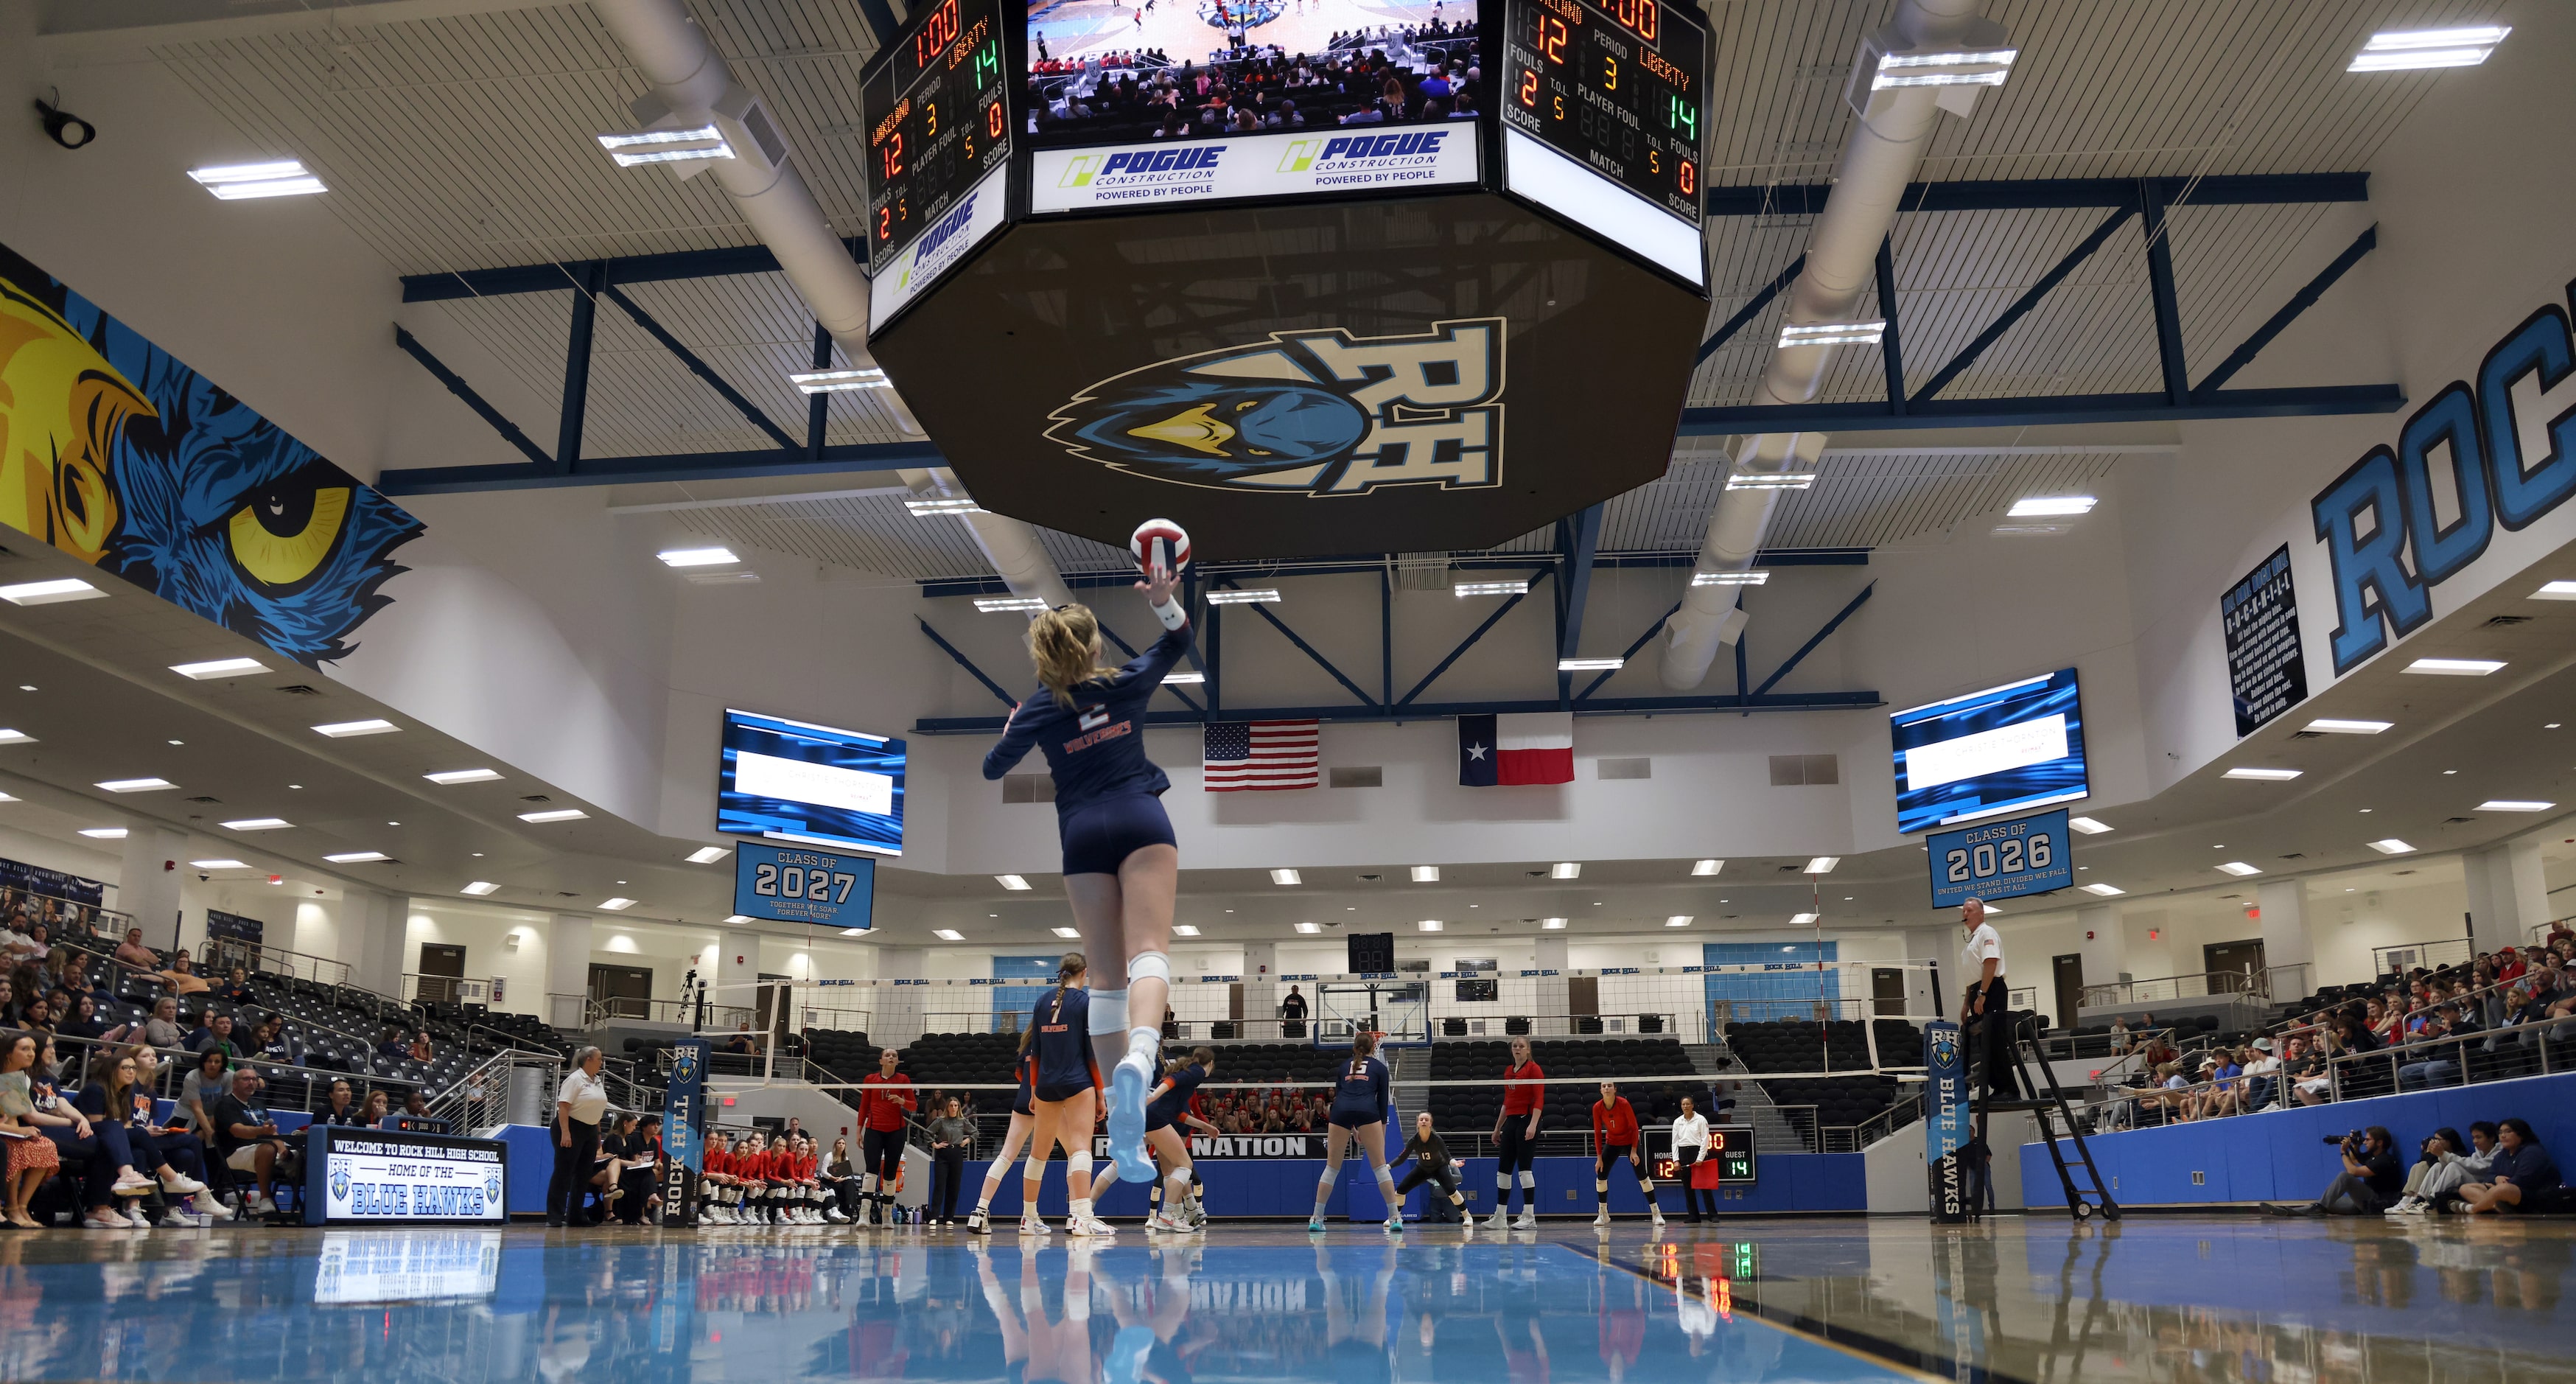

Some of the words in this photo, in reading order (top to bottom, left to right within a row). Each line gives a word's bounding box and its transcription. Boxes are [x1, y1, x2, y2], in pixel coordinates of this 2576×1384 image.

[948, 15, 988, 70] LIBERTY
[1539, 15, 1567, 64] 12
[1594, 28, 1628, 60] PERIOD
[976, 40, 998, 91] 14
[1511, 43, 1544, 74] FOULS
[1605, 56, 1617, 91] 3
[1639, 46, 1689, 91] LIBERTY
[917, 75, 942, 109] PERIOD
[979, 80, 1004, 113] FOULS
[1522, 70, 1537, 106] 2
[1550, 77, 1569, 97] T.O.L.
[926, 103, 937, 136] 3
[990, 102, 1002, 138] 0
[1507, 104, 1541, 133] SCORE
[1554, 96, 1564, 121] 5
[1578, 83, 1614, 116] PLAYER
[1617, 105, 1640, 130] FOUL
[1671, 95, 1695, 141] 14
[885, 133, 903, 179] 12
[912, 144, 938, 177] PLAYER
[939, 126, 957, 152] FOUL
[965, 136, 974, 159] 5
[983, 138, 1008, 170] SCORE
[1320, 130, 1449, 160] POGUE
[1646, 133, 1664, 152] T.O.L.
[1670, 137, 1698, 164] FOULS
[1101, 146, 1228, 175] POGUE
[1315, 155, 1437, 170] CONSTRUCTION
[1589, 149, 1624, 179] MATCH
[1650, 150, 1659, 174] 5
[1096, 170, 1215, 186] CONSTRUCTION
[1096, 189, 1150, 200] POWERED
[1154, 188, 1167, 196] BY
[1171, 185, 1213, 195] PEOPLE
[1316, 174, 1371, 185] POWERED
[1375, 173, 1390, 181] BY
[1393, 170, 1435, 181] PEOPLE
[1681, 161, 1693, 195] 0
[872, 187, 892, 215] FOULS
[899, 198, 907, 220] 5
[925, 191, 950, 223] MATCH
[1668, 192, 1697, 219] SCORE
[881, 207, 890, 240] 2
[914, 190, 979, 268] POGUE
[875, 241, 895, 268] SCORE
[910, 266, 937, 296] POWERED
[938, 260, 946, 271] BY
[947, 238, 970, 265] PEOPLE
[911, 223, 970, 281] CONSTRUCTION
[2311, 279, 2576, 679] ROC
[1966, 827, 2007, 845] CLASS
[2010, 823, 2027, 837] OF
[777, 852, 818, 867] CLASS
[821, 857, 838, 869] OF
[1946, 833, 2051, 883] 2026
[755, 863, 856, 905] 2027
[1937, 887, 1963, 895] UNITED
[1964, 884, 1976, 892] WE
[2003, 875, 2034, 884] DIVIDED
[2034, 872, 2048, 880] WE
[2049, 868, 2068, 877] FALL
[2012, 884, 2026, 892] ALL
[770, 901, 805, 909] TOGETHER
[807, 904, 818, 912] WE
[777, 909, 808, 918] FOREVER
[1931, 1030, 1959, 1044] RH
[673, 1045, 699, 1060] RH
[1940, 1077, 1955, 1130] BLUE
[671, 1095, 689, 1148] HILL
[334, 1139, 383, 1155] WELCOME
[385, 1144, 398, 1155] TO
[399, 1144, 424, 1157] ROCK
[424, 1146, 445, 1158] HILL
[447, 1147, 466, 1160] HIGH
[468, 1149, 499, 1162] SCHOOL
[1191, 1137, 1306, 1156] NATION
[1421, 1152, 1431, 1160] 13
[388, 1164, 417, 1177] HOME
[420, 1165, 432, 1177] OF
[435, 1167, 454, 1178] THE
[1659, 1161, 1674, 1178] 12
[1732, 1161, 1747, 1175] 14
[1942, 1136, 1960, 1215] HAWKS
[351, 1183, 407, 1215] BLUE
[413, 1185, 484, 1215] HAWKS
[666, 1155, 685, 1216] ROCK
